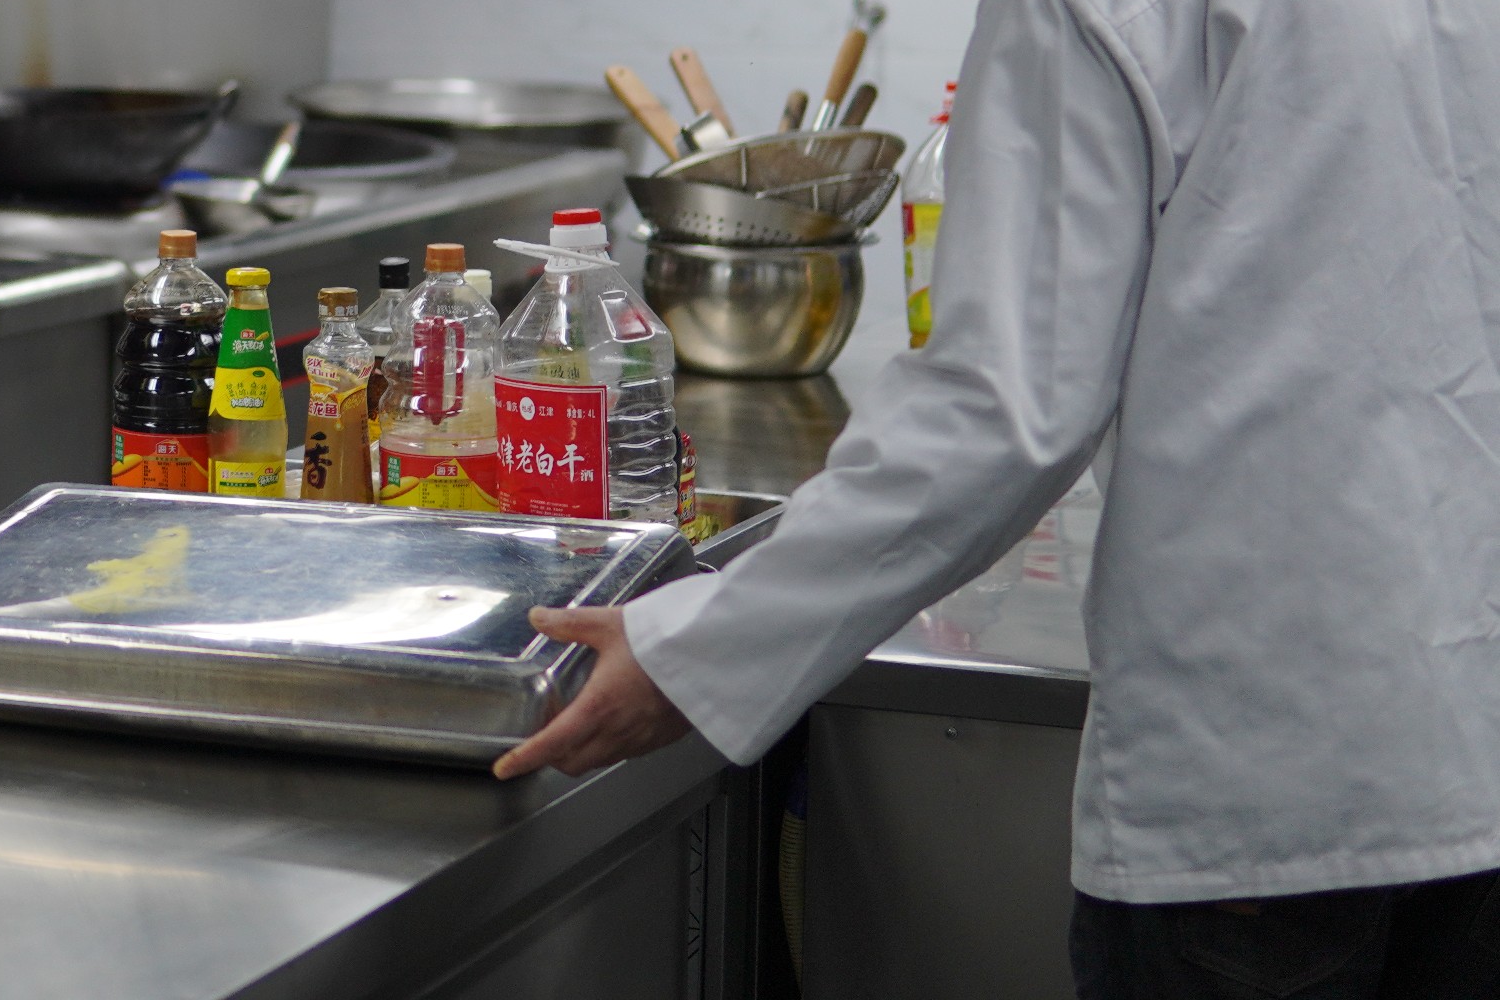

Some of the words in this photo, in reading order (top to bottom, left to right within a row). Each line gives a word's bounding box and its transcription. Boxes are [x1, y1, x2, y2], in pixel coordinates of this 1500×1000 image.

[157, 444, 177, 454] 海天
[497, 433, 585, 482] 津老白干
[580, 468, 594, 482] 酒
[436, 466, 456, 476] 海天
